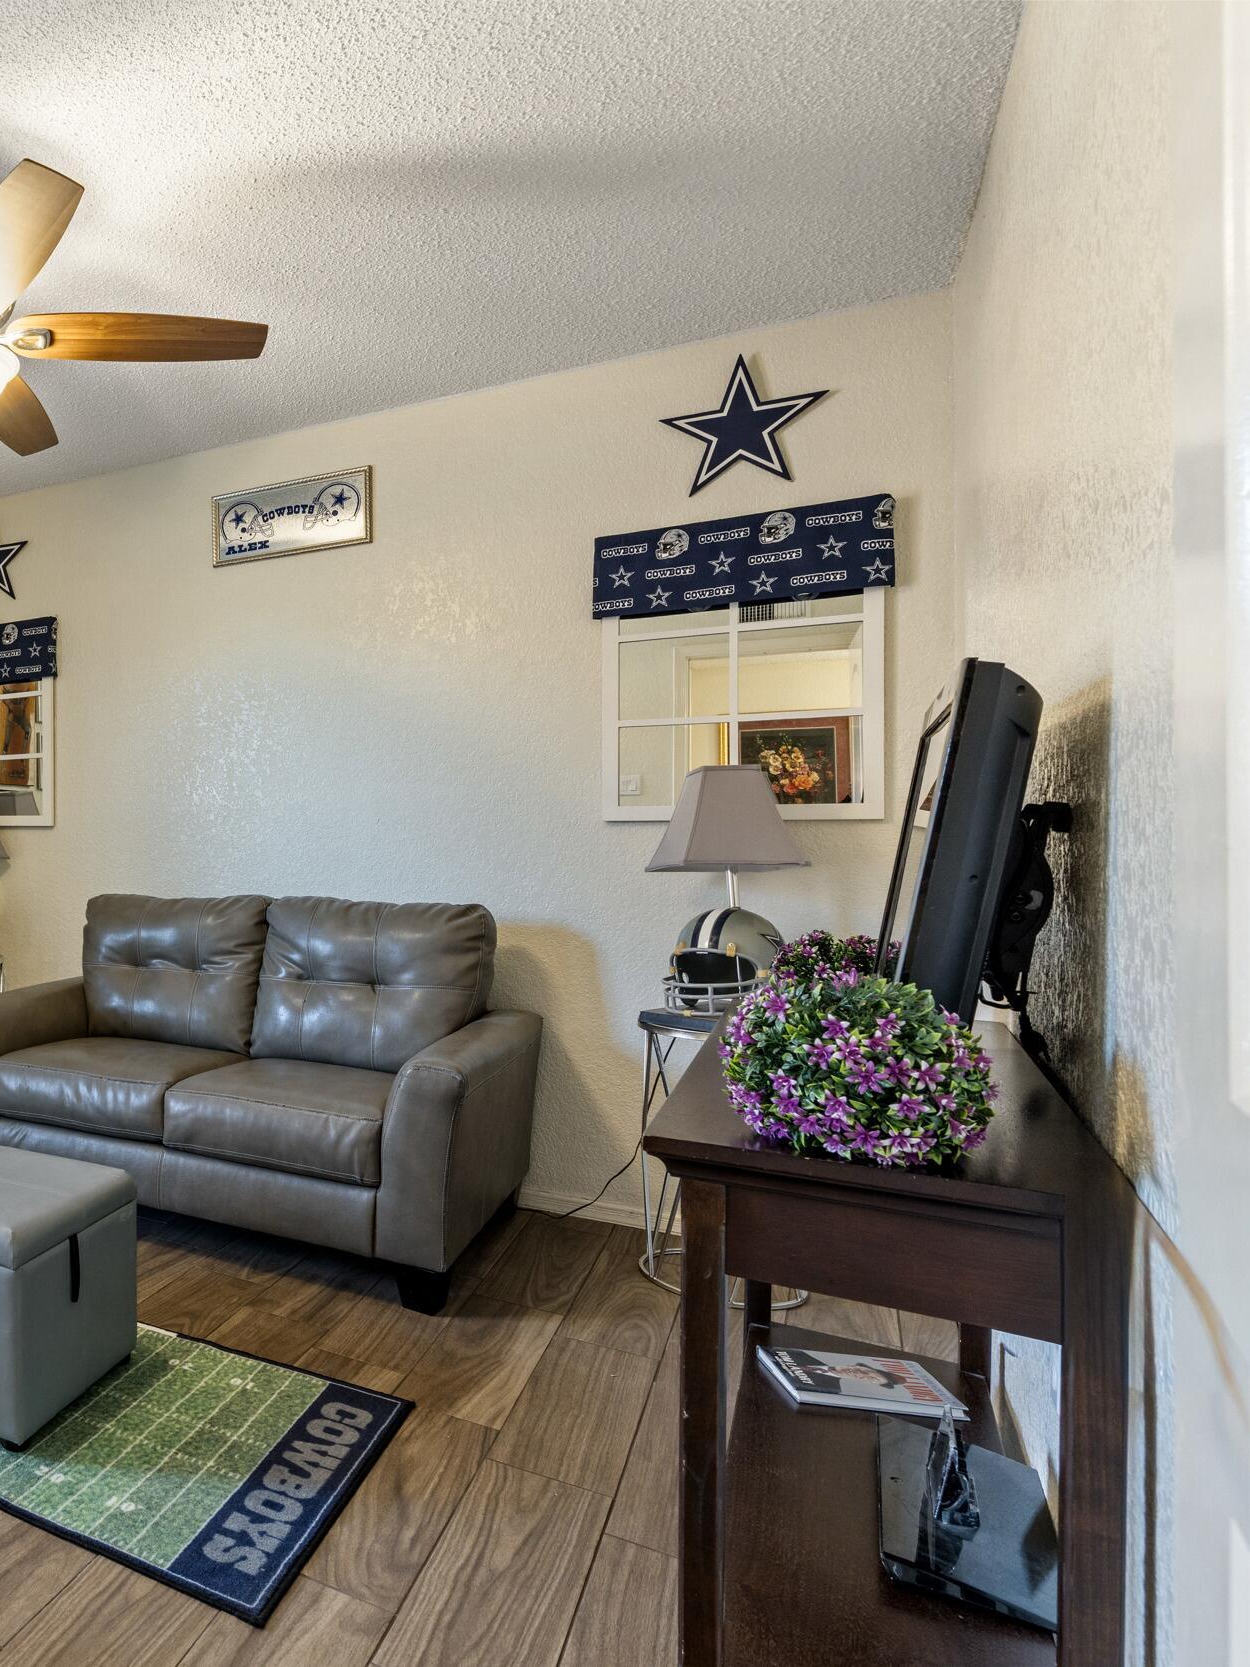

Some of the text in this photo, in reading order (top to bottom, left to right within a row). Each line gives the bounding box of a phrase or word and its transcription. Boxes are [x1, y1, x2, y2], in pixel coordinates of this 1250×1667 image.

[262, 504, 315, 523] COWBOYS
[806, 511, 862, 527] COWBOYS
[699, 527, 750, 544] COWBOYS
[226, 540, 270, 555] ALEX
[601, 543, 647, 558] COWBOYS
[748, 548, 802, 565] COWBOYS
[646, 565, 695, 579] COWBOYS
[791, 571, 847, 586] COWBOYS
[684, 585, 735, 600] COWBOYS
[202, 1401, 374, 1576] COWBOYS
